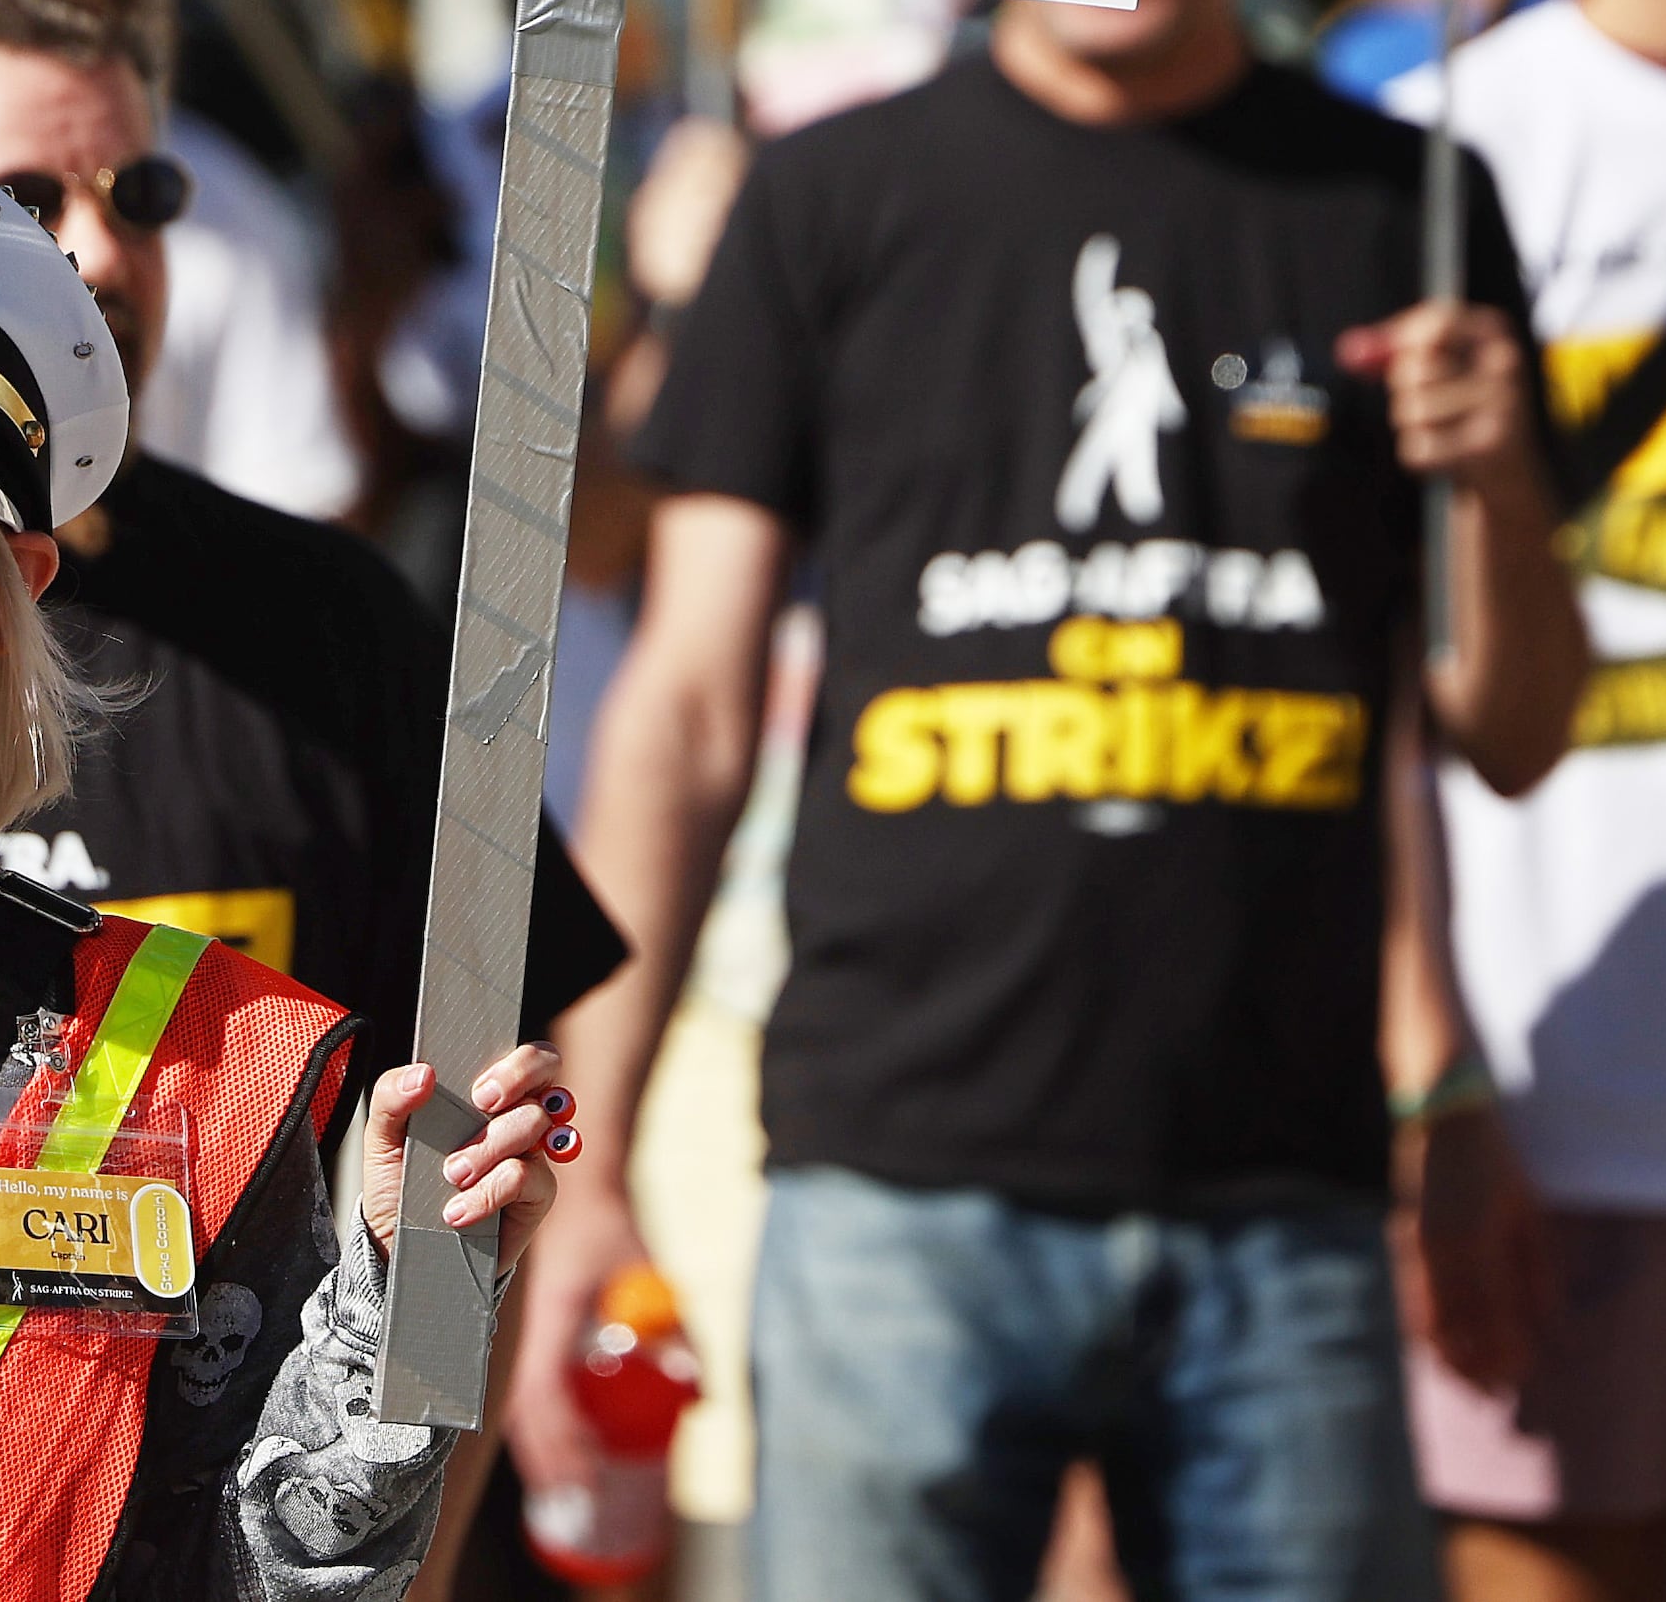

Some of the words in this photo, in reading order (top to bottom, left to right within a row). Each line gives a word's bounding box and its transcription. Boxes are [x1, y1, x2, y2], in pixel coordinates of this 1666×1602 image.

[44, 1186, 67, 1199] my
[70, 1188, 113, 1199] name
[116, 1188, 129, 1201] is
[22, 1209, 110, 1244] CARI
[153, 1191, 169, 1249] Captain!
[159, 1252, 174, 1292] Strike
[83, 1287, 98, 1297] ON
